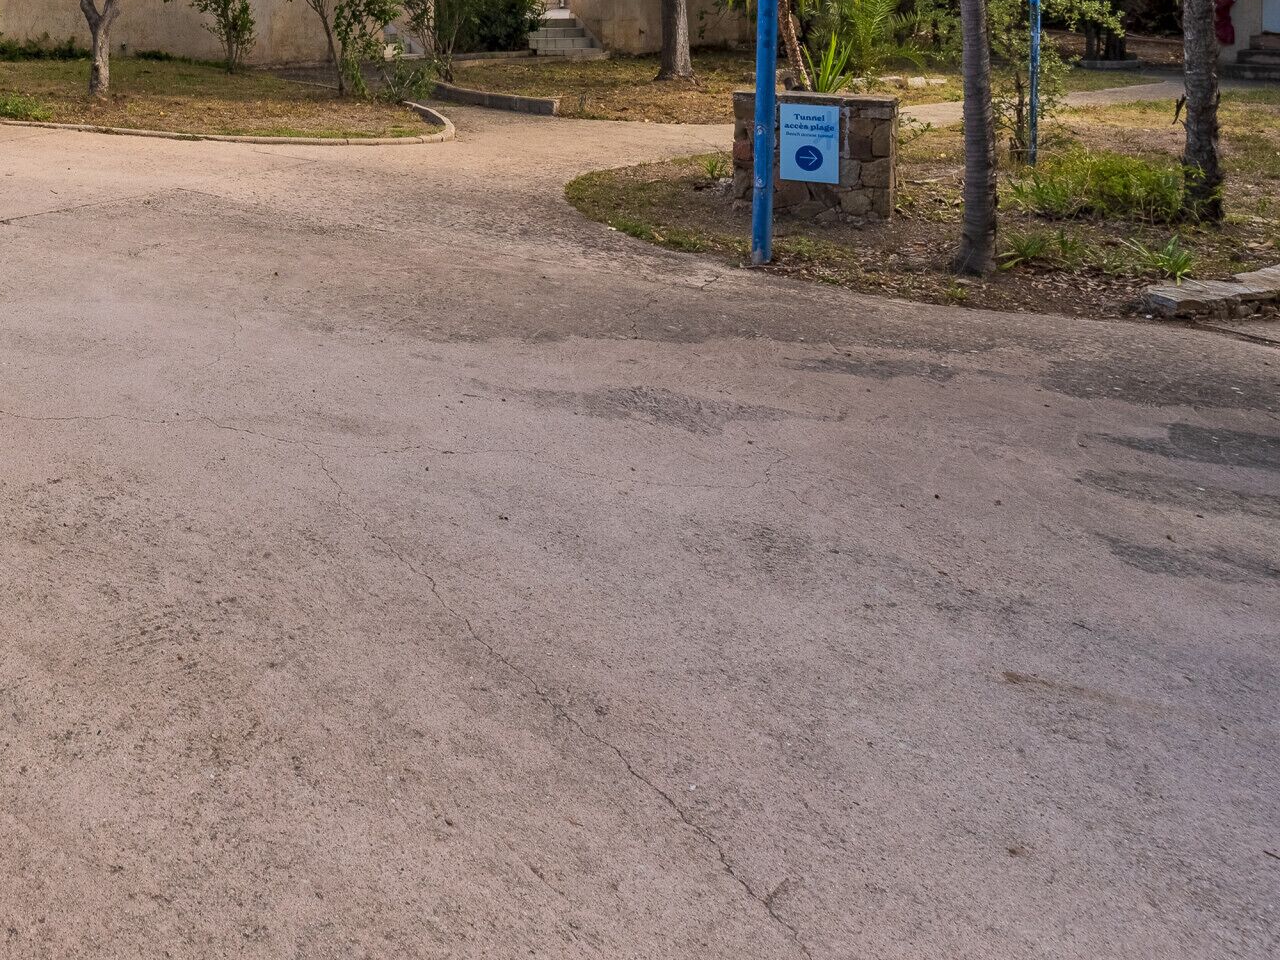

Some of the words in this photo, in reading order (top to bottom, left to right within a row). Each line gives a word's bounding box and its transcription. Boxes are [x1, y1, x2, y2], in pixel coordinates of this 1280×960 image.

[793, 113, 825, 122] Tunnel
[784, 122, 809, 130] accès
[810, 123, 835, 132] plage
